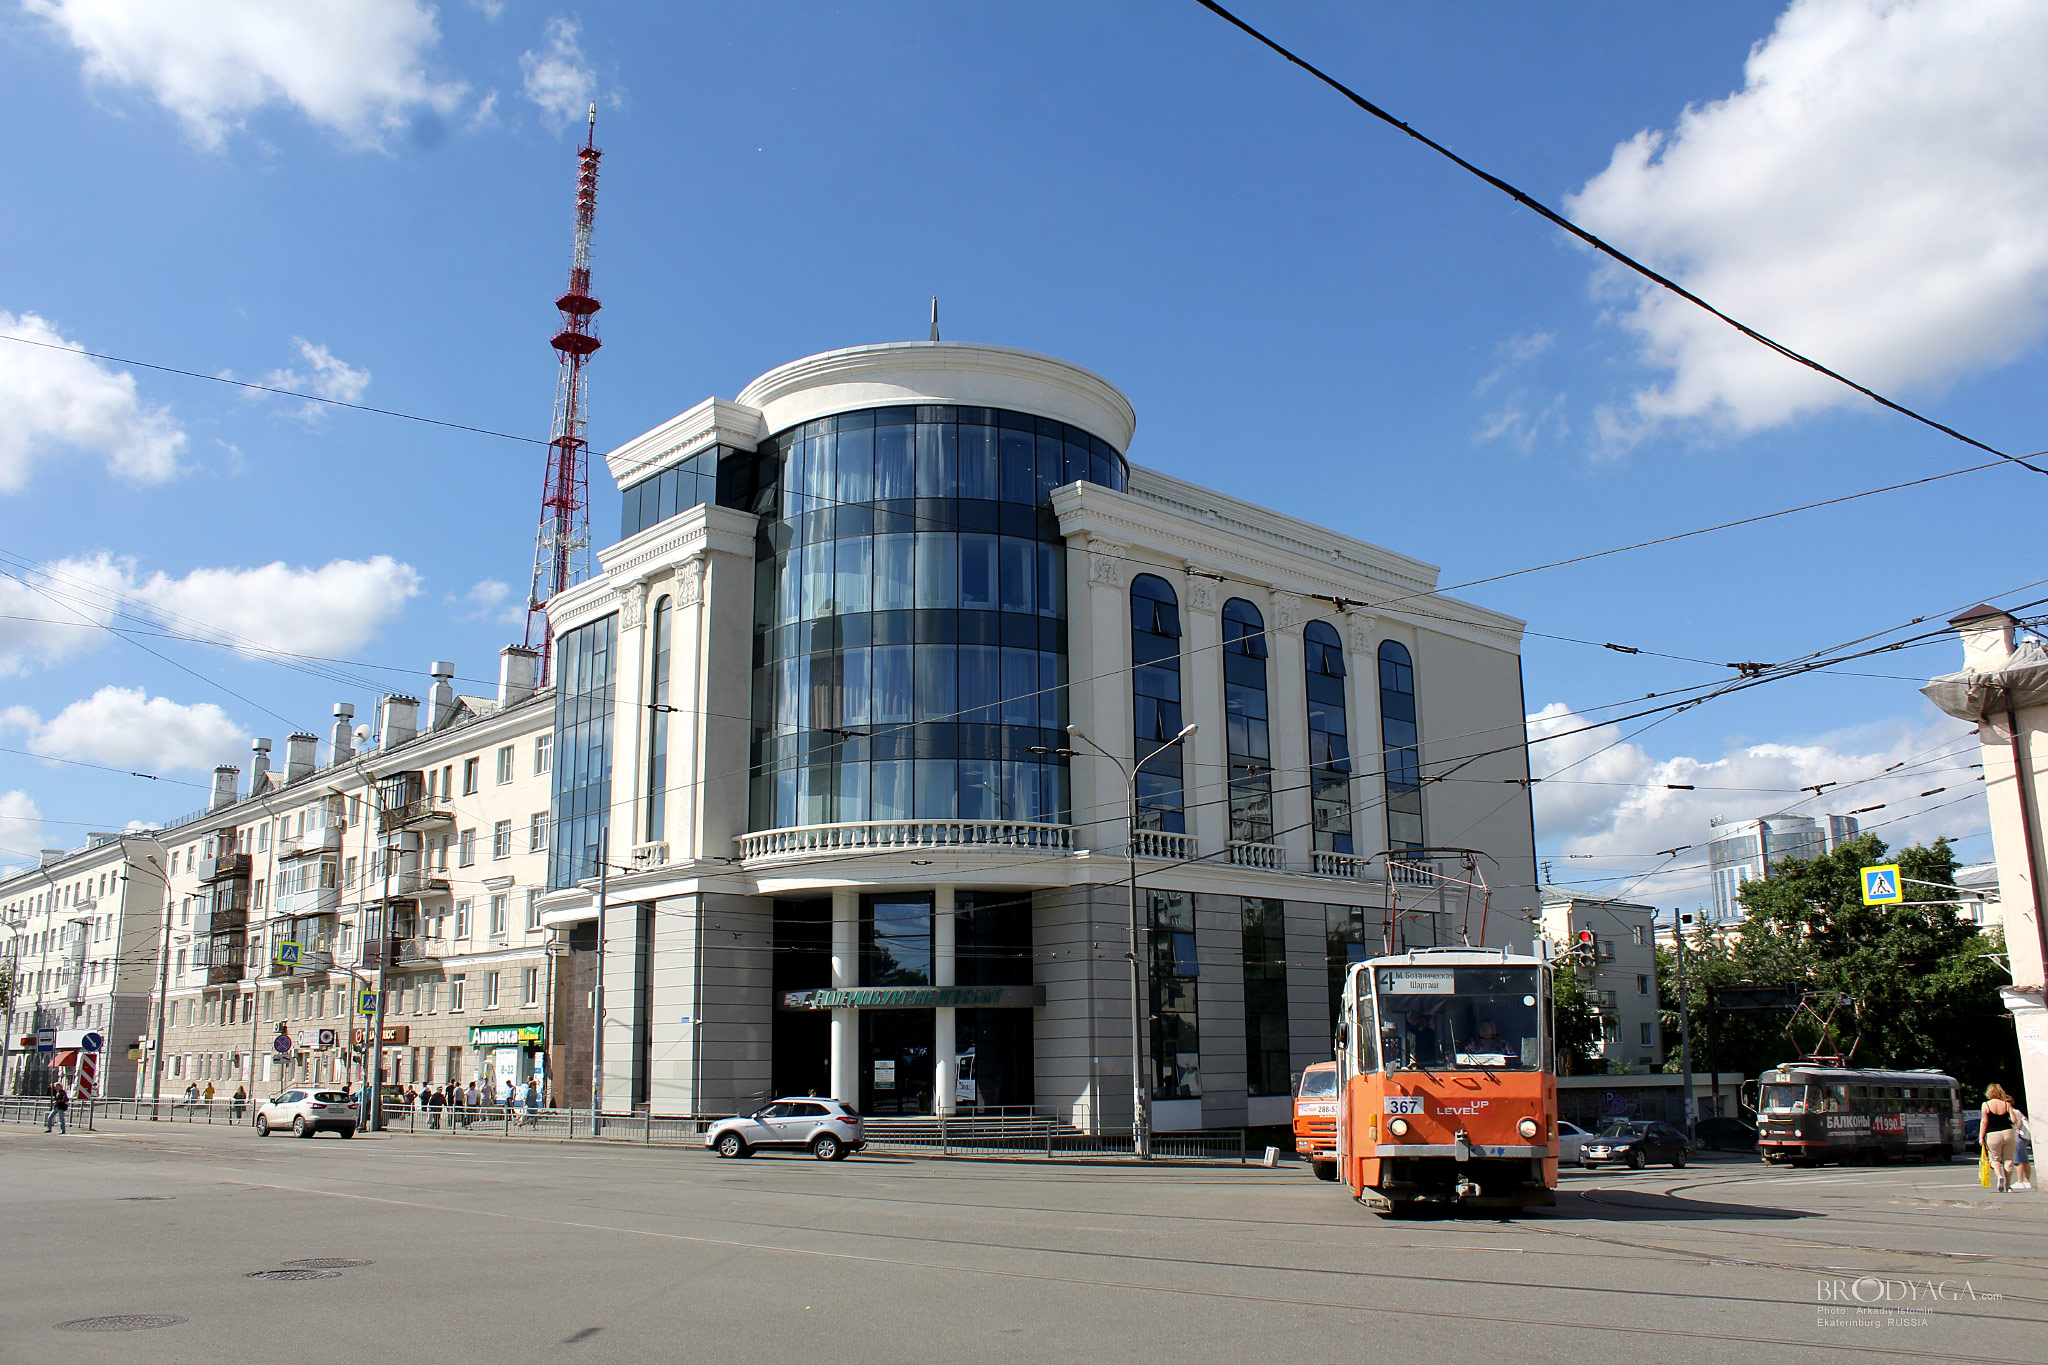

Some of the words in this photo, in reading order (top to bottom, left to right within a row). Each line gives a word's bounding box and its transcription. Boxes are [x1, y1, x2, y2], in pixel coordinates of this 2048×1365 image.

[1380, 972, 1395, 991] 4
[1410, 981, 1439, 990] Шарташ
[815, 988, 1004, 1007] ЕКАТЕРИНБУРГЭНЕРГОСБЫТ
[472, 1028, 518, 1044] Аптека
[500, 1065, 514, 1075] 8-22
[1390, 1101, 1418, 1114] 367
[1826, 1115, 1870, 1128] БАЛКОНЫ
